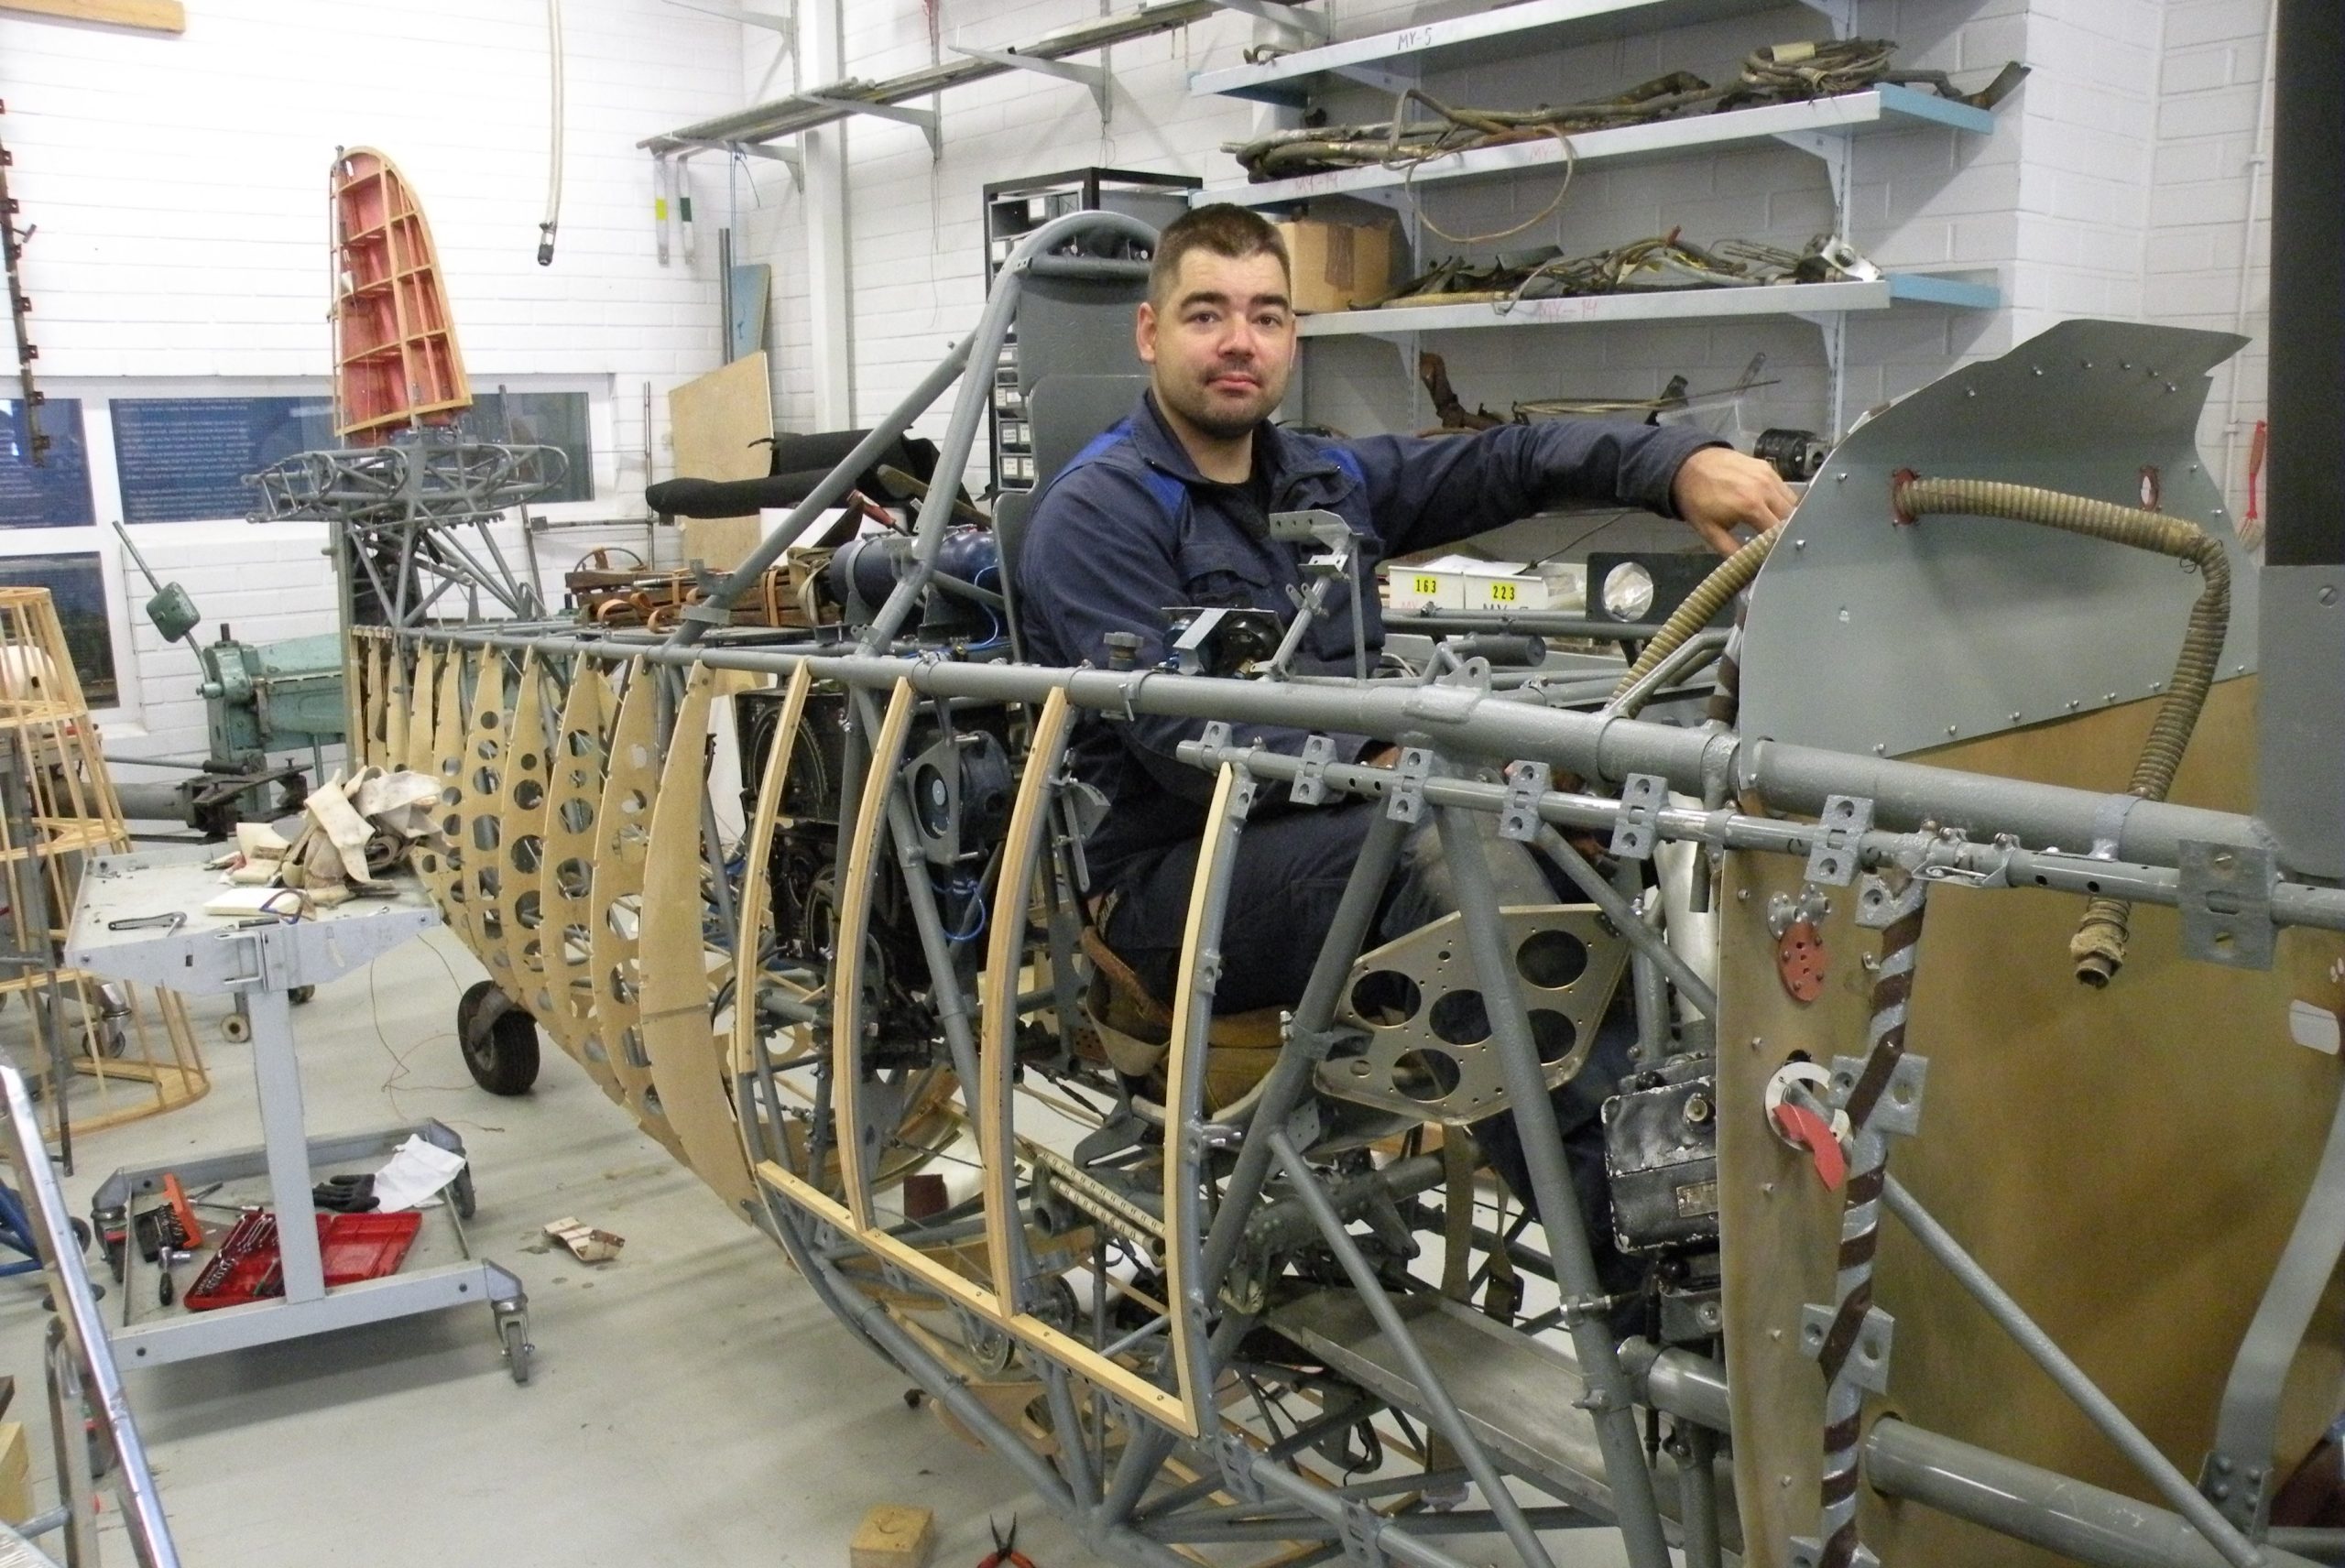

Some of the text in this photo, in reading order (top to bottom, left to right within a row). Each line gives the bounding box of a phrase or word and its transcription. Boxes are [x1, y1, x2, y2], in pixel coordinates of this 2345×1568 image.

[1397, 27, 1432, 50] MY-5
[1416, 579, 1436, 593] 163
[1493, 585, 1515, 601] 223
